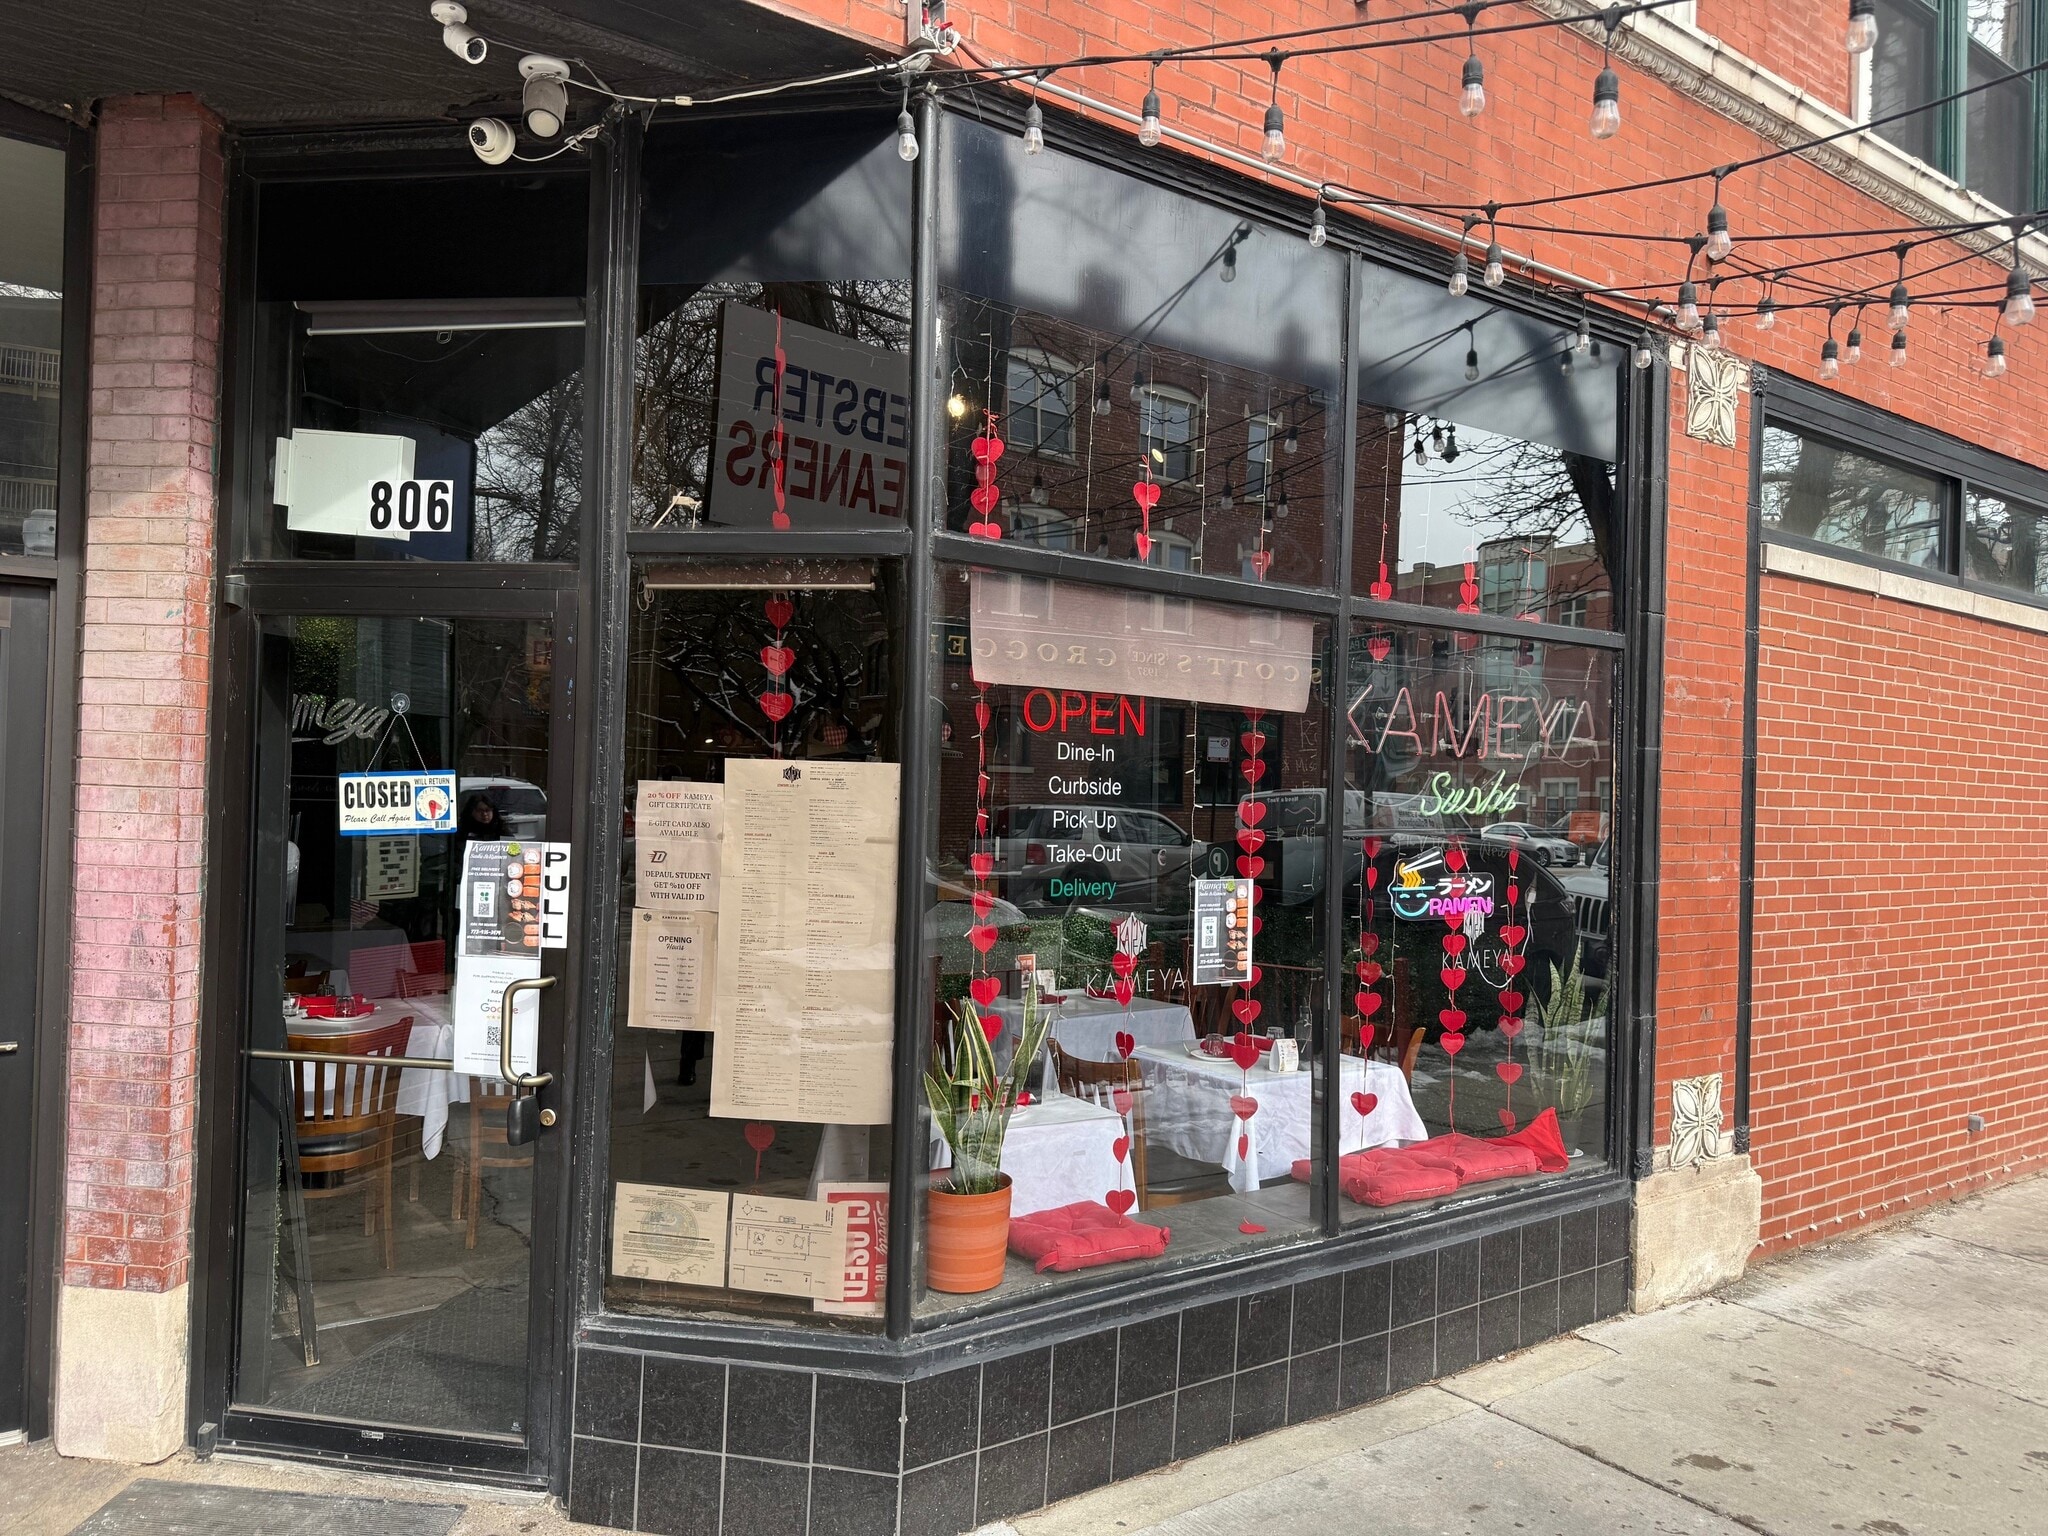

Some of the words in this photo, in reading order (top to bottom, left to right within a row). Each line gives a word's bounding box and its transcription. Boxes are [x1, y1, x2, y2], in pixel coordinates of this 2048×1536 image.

[370, 481, 449, 530] 806
[1023, 688, 1146, 737] OPEN
[1347, 683, 1600, 761] KAMEYA
[1057, 742, 1115, 762] Dine-In
[428, 777, 450, 785] RETURN
[1048, 775, 1122, 796] Curbside
[344, 780, 411, 809] CLOSED
[684, 793, 714, 801] KAMEYA
[1421, 768, 1520, 817] Sushi
[666, 802, 712, 810] CERTIFICATE
[344, 815, 368, 824] Please
[370, 813, 386, 823] Call
[387, 814, 411, 825] Again
[648, 820, 671, 828] E-GIFT
[692, 821, 711, 829] ALSO
[1052, 810, 1117, 833] Pick-Up
[659, 829, 699, 838] AVAILABLE
[472, 843, 510, 854] Kameya
[1046, 844, 1122, 863] Take-Out
[645, 870, 675, 878] DEPAUL
[675, 871, 711, 880] STUDENT
[653, 881, 668, 889] GET
[669, 882, 685, 890] %10
[1050, 878, 1117, 900] Delivery
[1438, 876, 1492, 895] ラーメン
[542, 852, 567, 939] PULL
[650, 891, 670, 899] WITH
[671, 892, 695, 900] VALID
[1430, 896, 1493, 916] RAMEN
[658, 935, 692, 944] OPENING
[666, 943, 685, 951] Hours
[1442, 948, 1514, 969] KAMEYA
[1086, 967, 1186, 997] KAMEYA
[480, 1002, 519, 1015] Gooe
